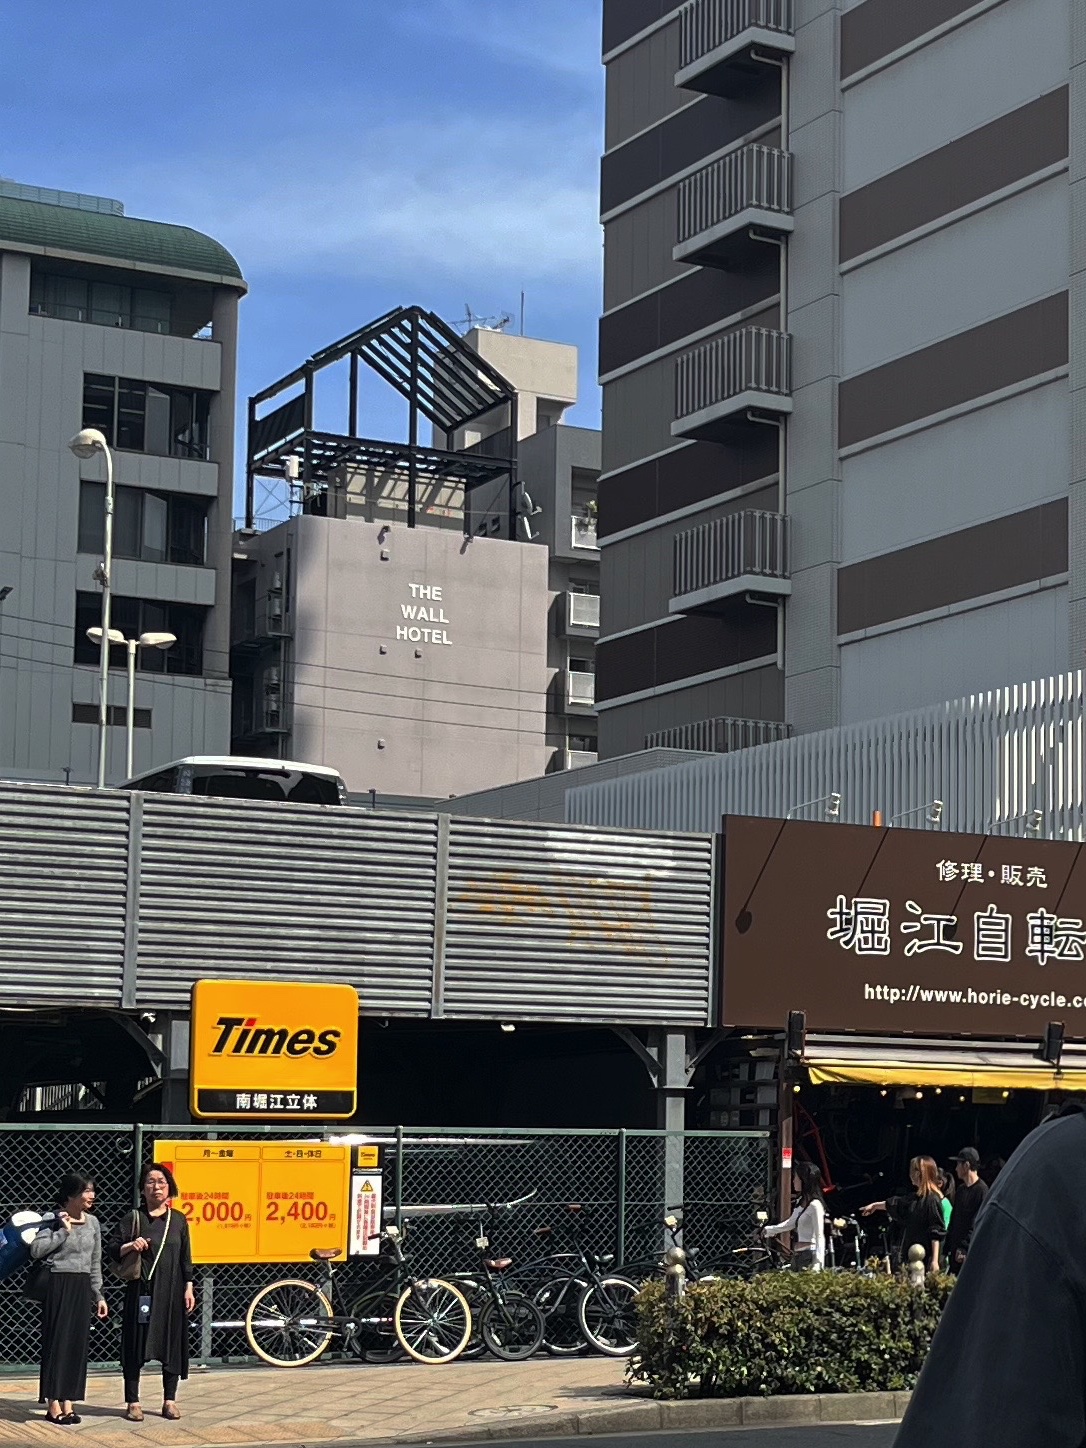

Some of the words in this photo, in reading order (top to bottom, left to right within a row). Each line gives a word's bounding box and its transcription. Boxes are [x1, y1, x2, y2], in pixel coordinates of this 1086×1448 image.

[408, 583, 443, 601] THE
[400, 604, 450, 624] WALL
[396, 625, 453, 645] HOTEL
[935, 859, 1049, 889] 修理・販売
[211, 1016, 342, 1056] Times
[235, 1093, 318, 1110] 南堀江立体
